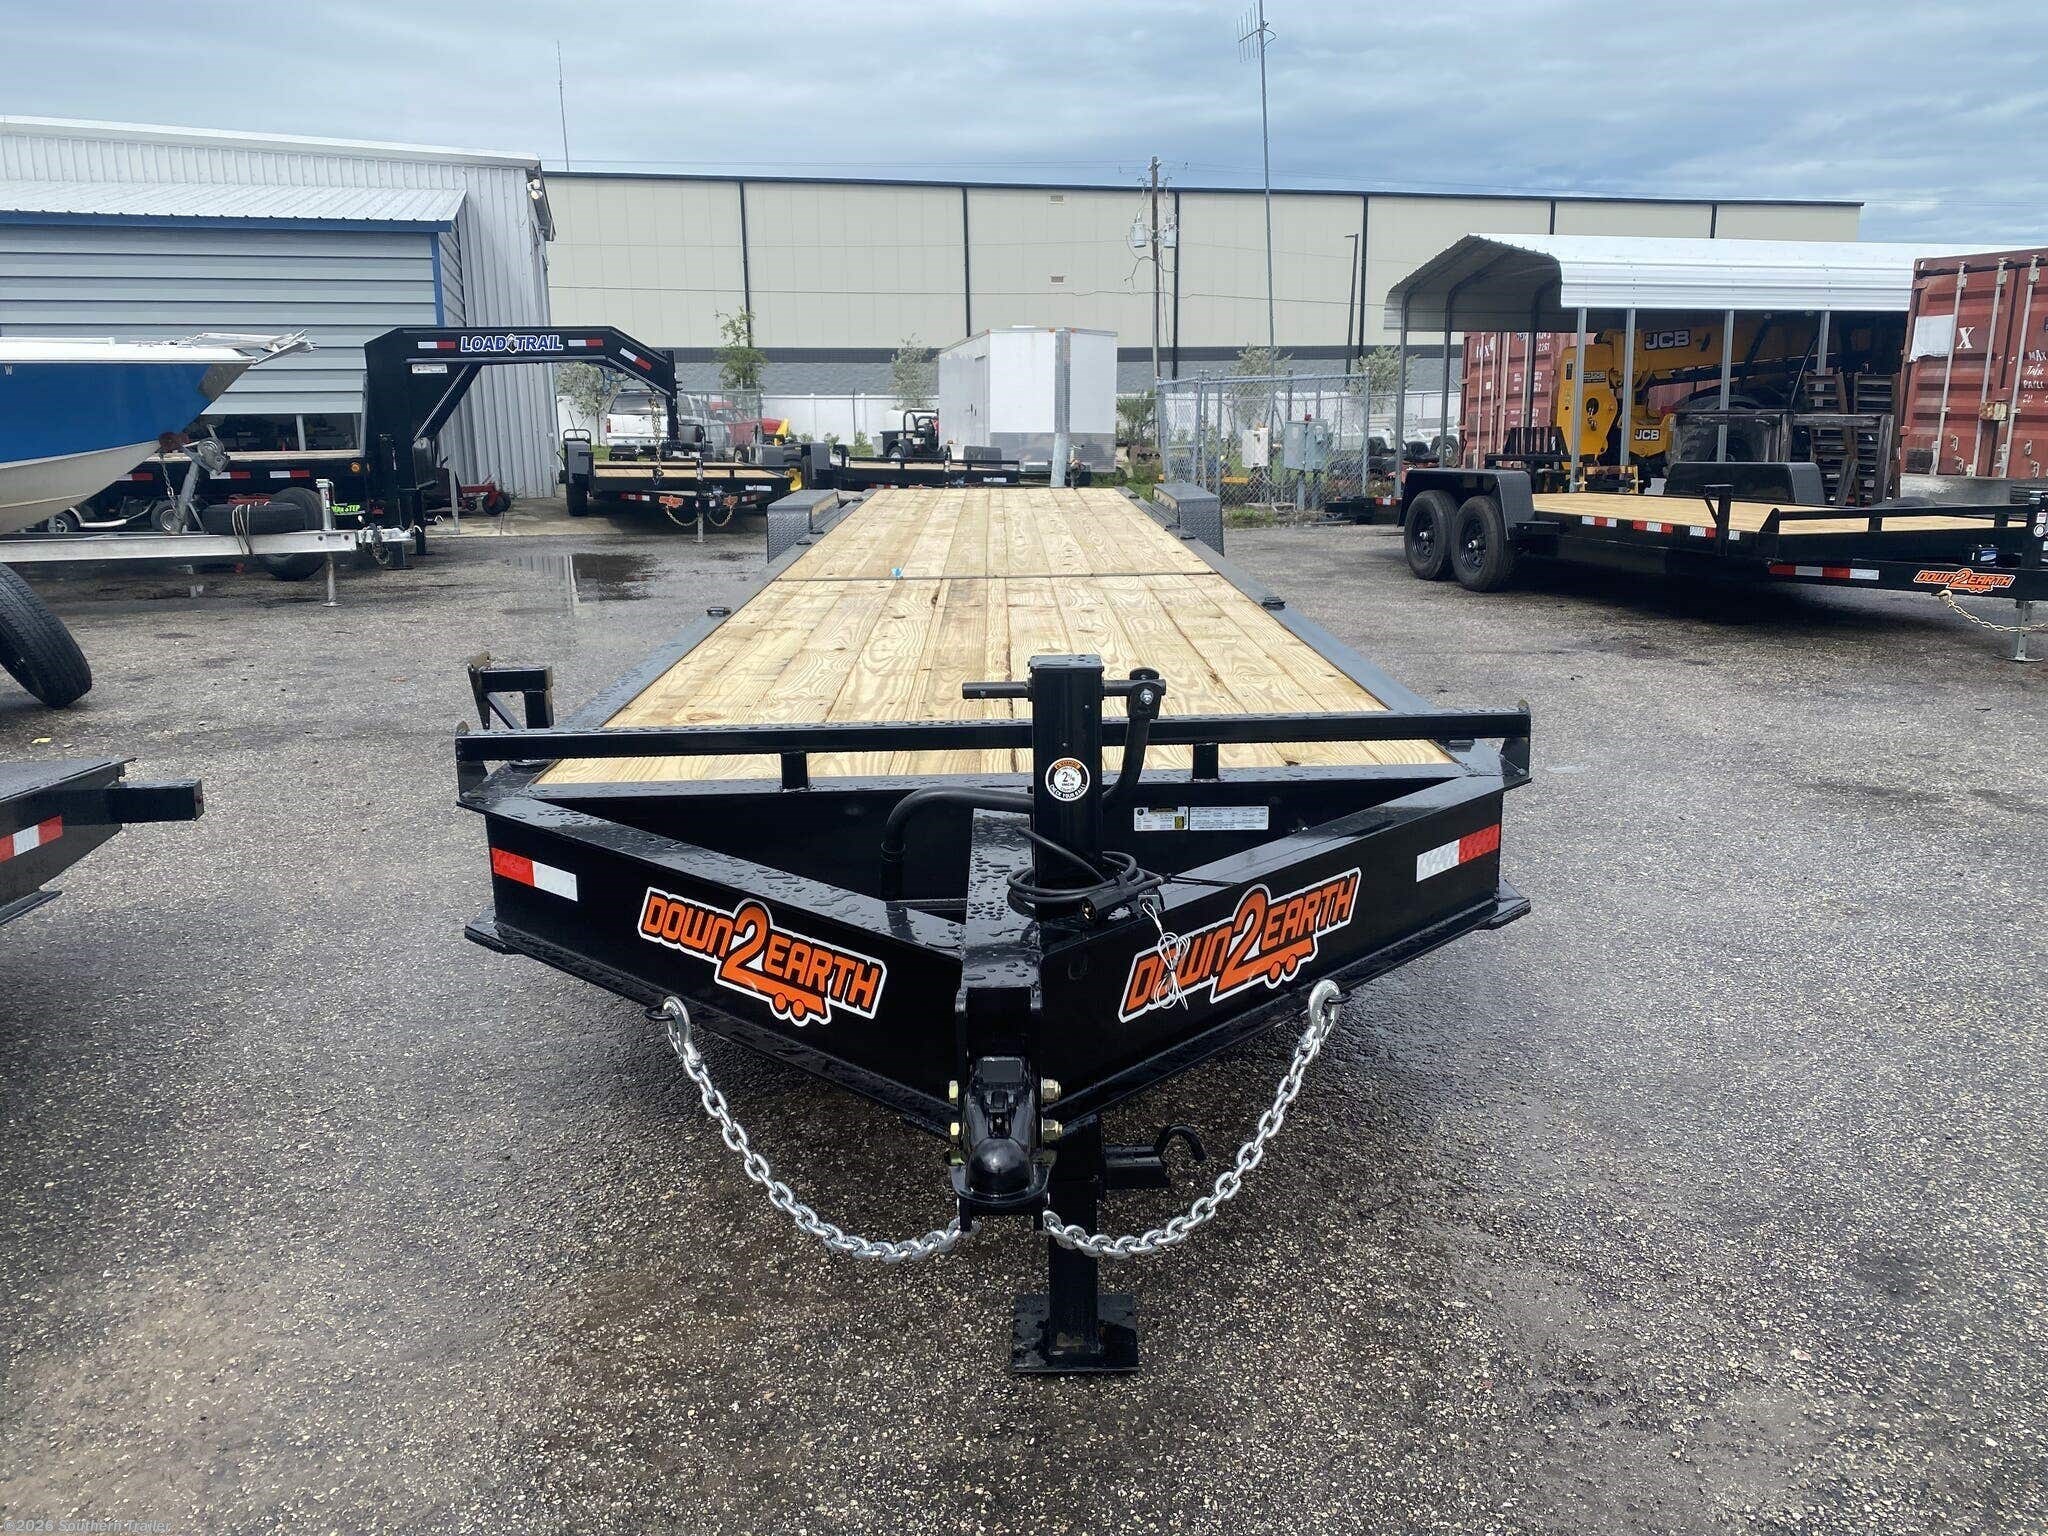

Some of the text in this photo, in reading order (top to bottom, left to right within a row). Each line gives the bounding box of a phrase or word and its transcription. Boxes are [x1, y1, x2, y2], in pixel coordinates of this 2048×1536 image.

[460, 335, 563, 352] LOAD TRAIL
[1645, 331, 1690, 350] JCB
[1635, 429, 1660, 441] JCB
[638, 888, 885, 1023] DOWN2EARTH
